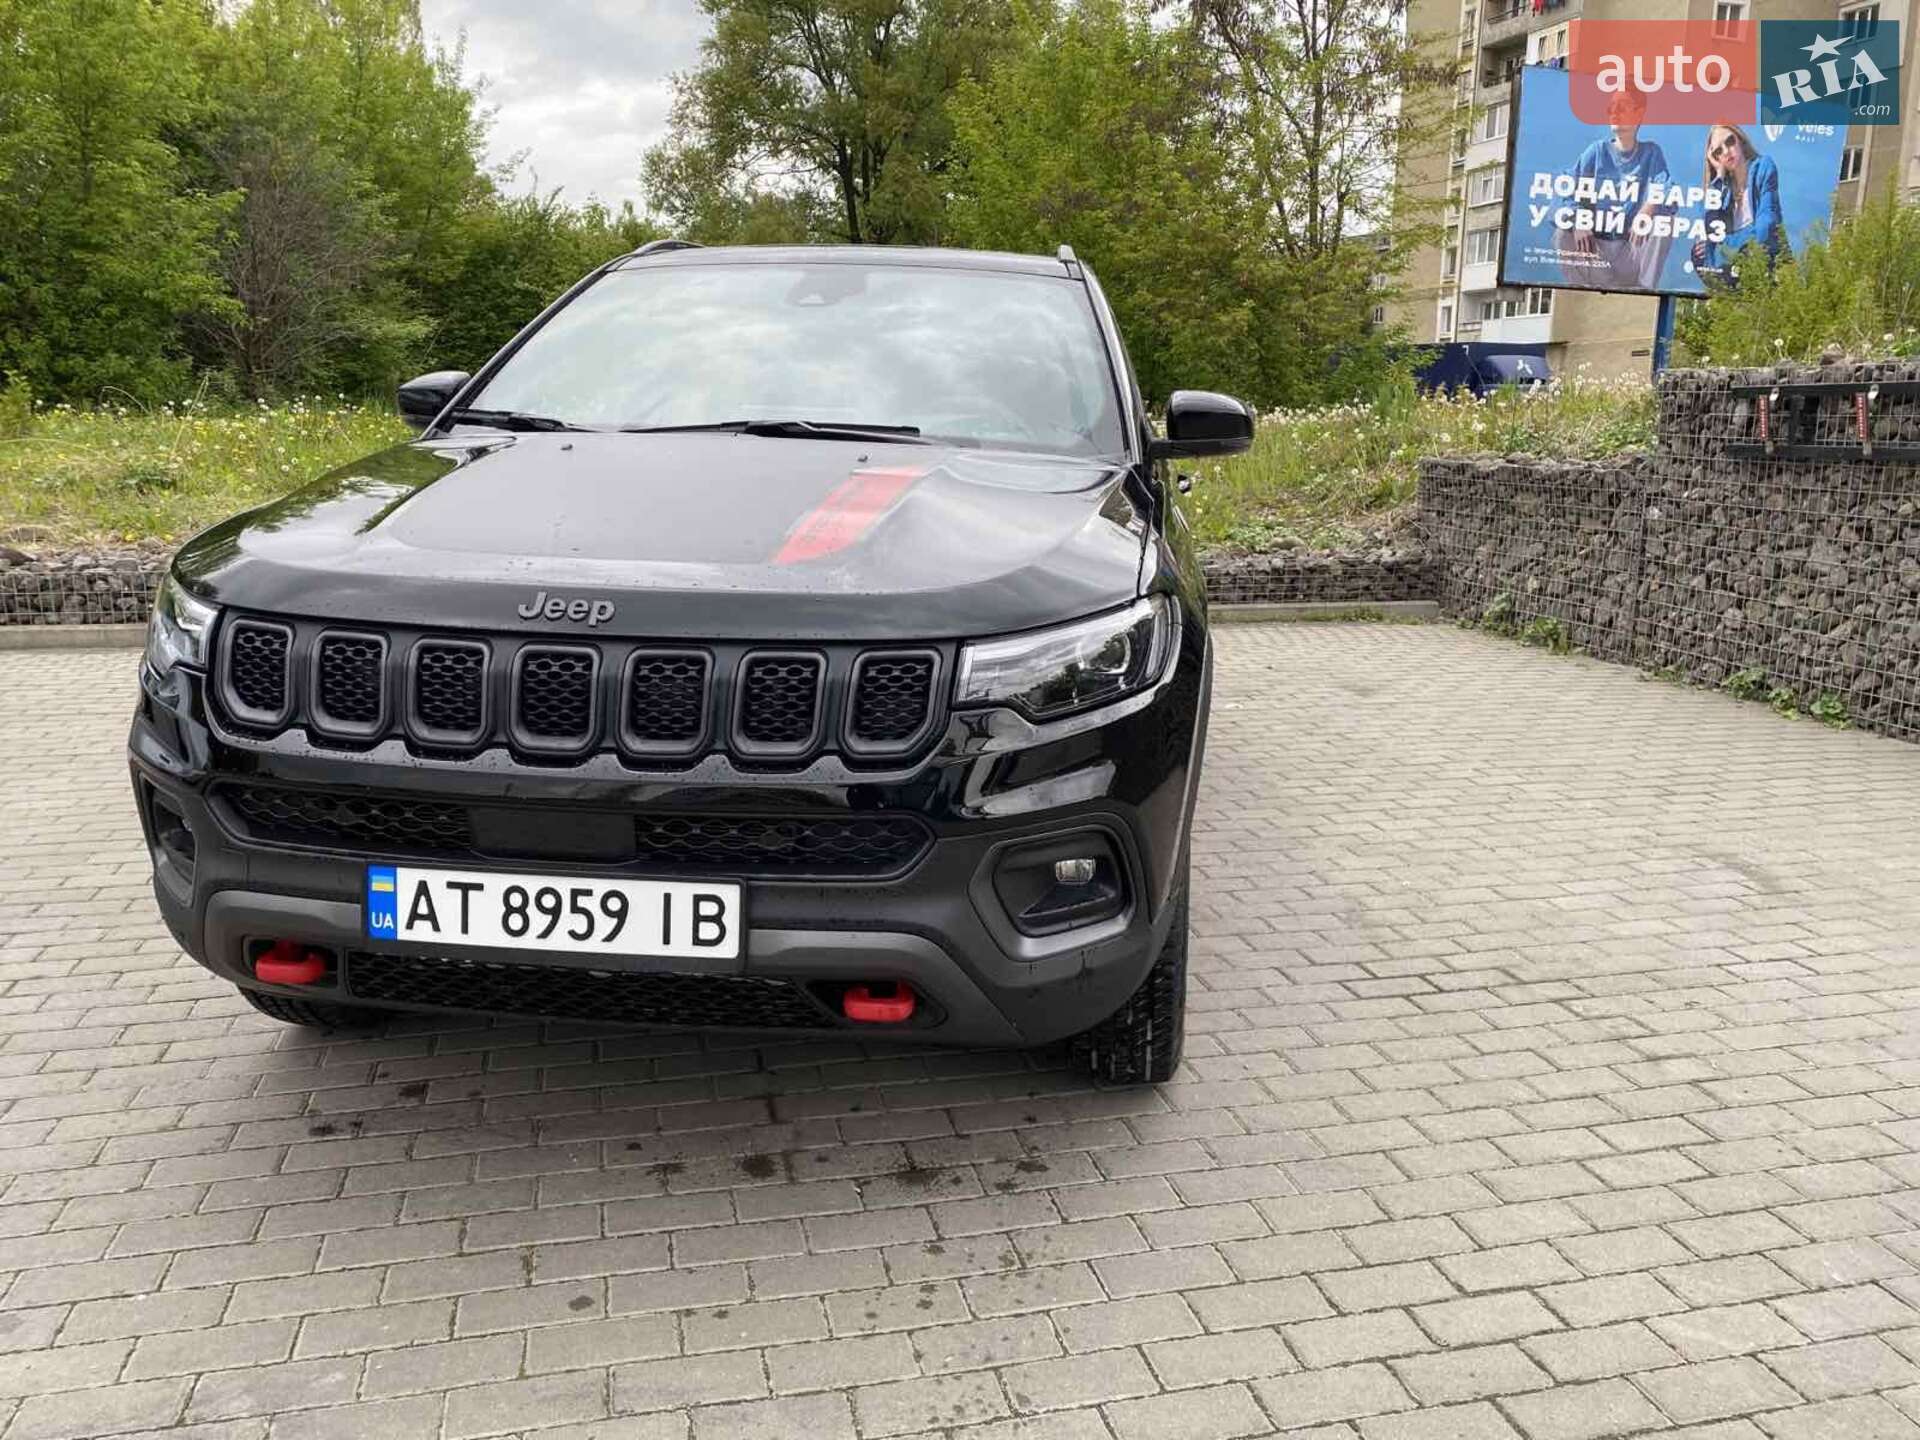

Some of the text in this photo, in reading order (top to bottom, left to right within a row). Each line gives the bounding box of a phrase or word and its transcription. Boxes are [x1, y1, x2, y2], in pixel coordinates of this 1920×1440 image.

[1529, 172, 1723, 211] ДОДАЙ БАРВ
[1528, 204, 1726, 243] У СВІЙ ОБРАЗ
[518, 591, 616, 627] Jeep
[371, 911, 394, 929] UA
[501, 885, 630, 943] 8959
